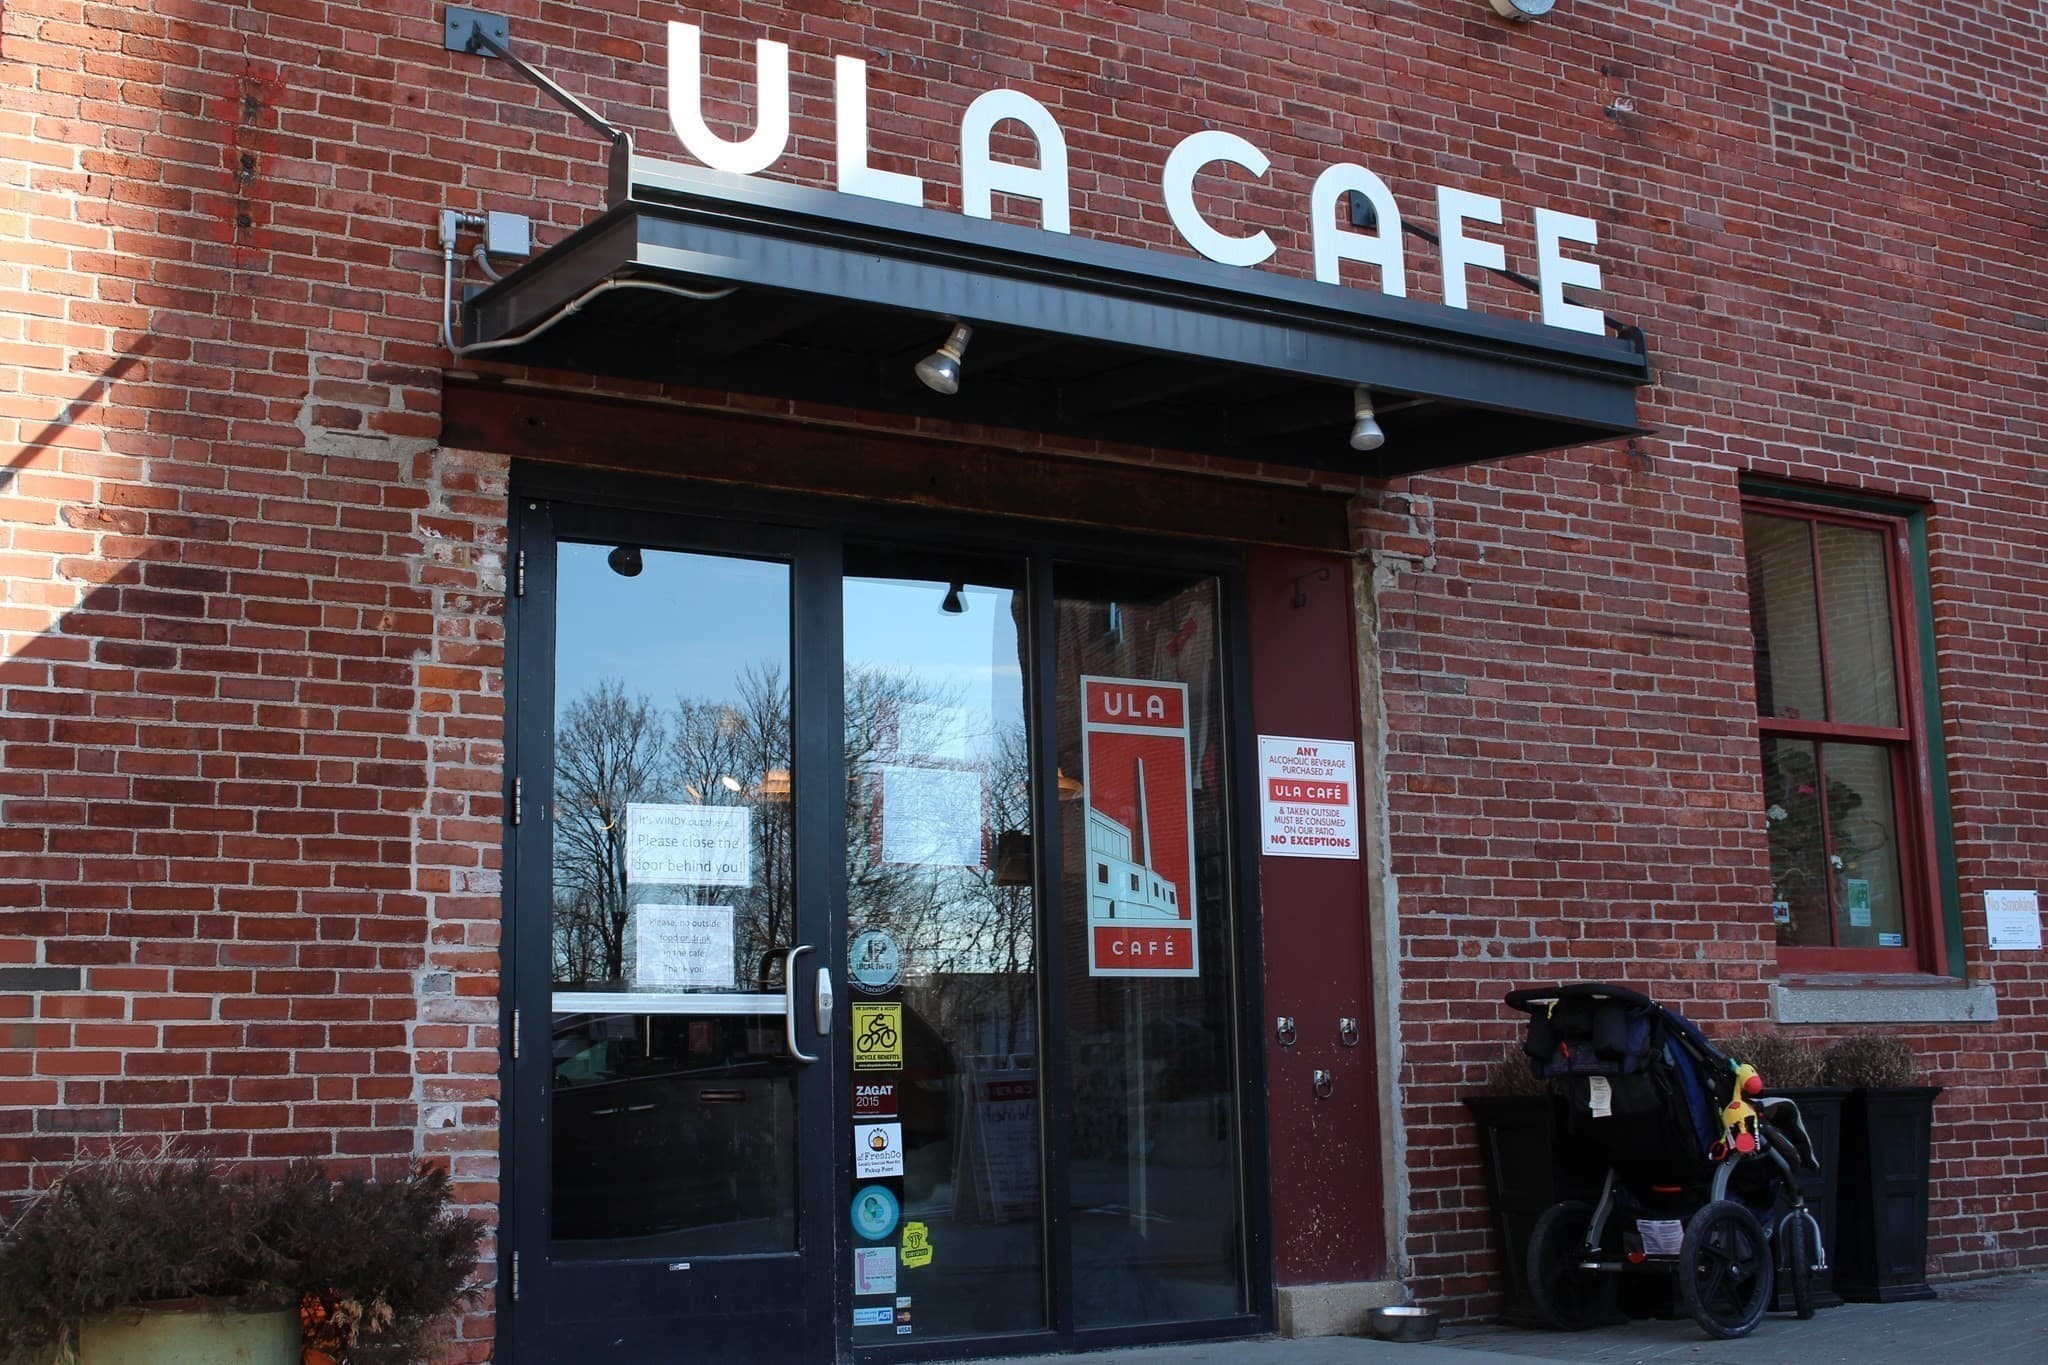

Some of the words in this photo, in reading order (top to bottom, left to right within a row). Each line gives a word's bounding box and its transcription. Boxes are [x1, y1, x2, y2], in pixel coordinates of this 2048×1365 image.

[667, 21, 1070, 234] ULA
[1162, 130, 1606, 337] CAFE
[1104, 691, 1164, 720] ULA
[1296, 746, 1318, 756] ANY
[1268, 756, 1310, 766] ALCOHOLIC
[1310, 758, 1346, 768] BEVERAGE
[1282, 766, 1324, 776] PURCHASED
[1325, 768, 1334, 776] AT
[1275, 785, 1302, 797] ULA
[1306, 784, 1341, 800] CAFÉ
[1279, 806, 1285, 814] &
[1286, 807, 1310, 816] TAKEN
[1310, 808, 1340, 818] OUTSIDE
[655, 816, 686, 826] WINDY
[1274, 816, 1294, 824] MUST
[1296, 817, 1304, 825] BE
[1305, 818, 1346, 827] CONSUMED
[1284, 826, 1296, 834] ON
[1298, 826, 1314, 835] OUR
[638, 834, 679, 847] Please
[682, 835, 714, 848] close
[718, 837, 740, 849] the
[1270, 835, 1286, 844] NO
[1290, 836, 1351, 847] EXCEPTIONS
[634, 858, 665, 871] door
[668, 859, 712, 872] behind
[715, 861, 744, 875] you!
[1112, 935, 1174, 956] CAFÉ
[856, 1086, 893, 1096] ZAGAT
[856, 1096, 880, 1107] 2015
